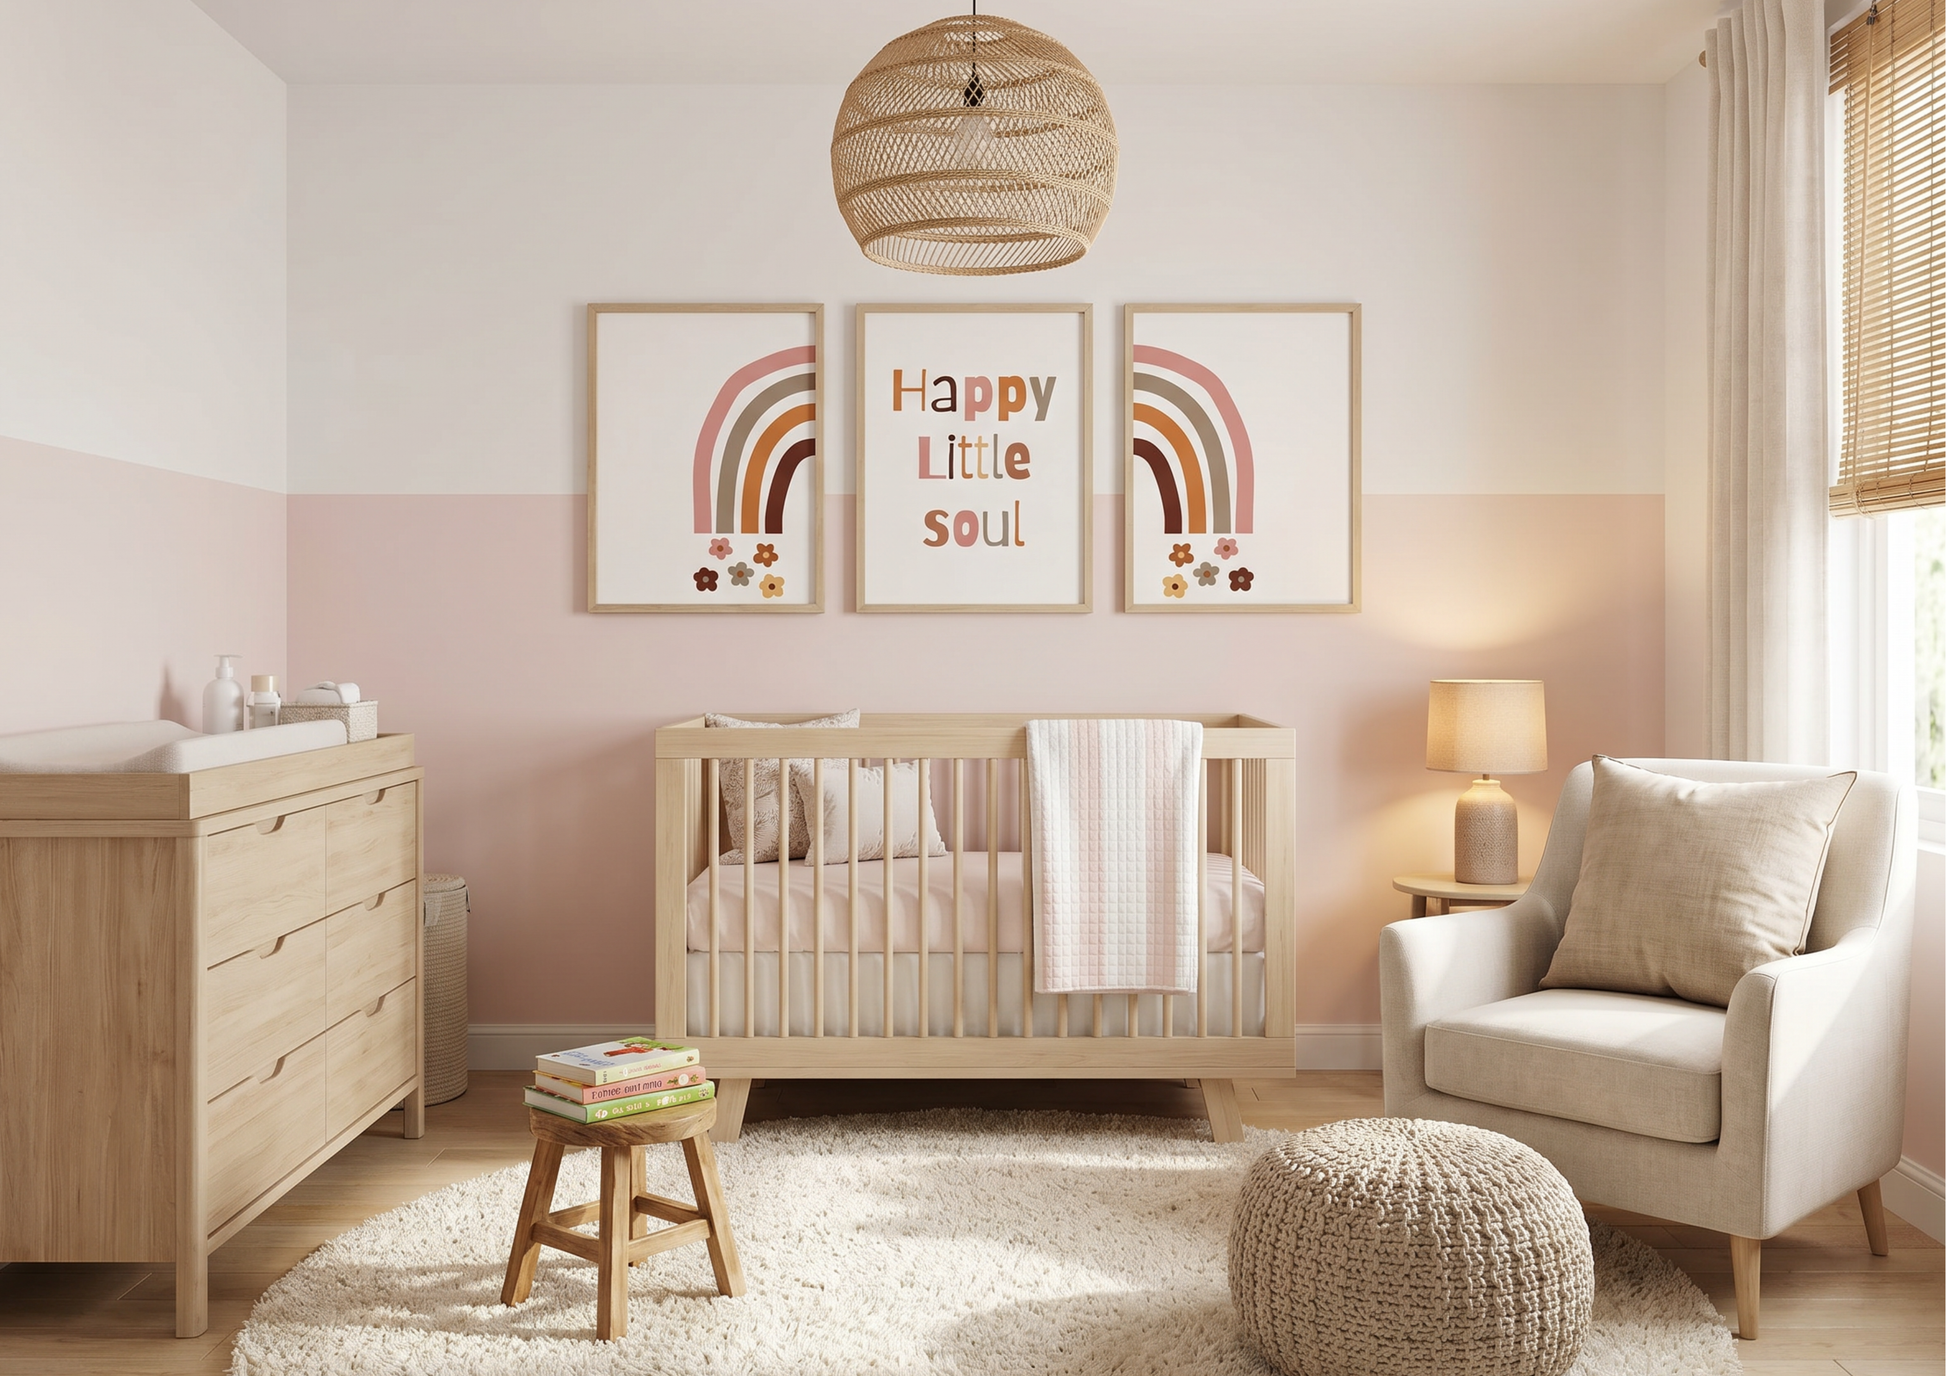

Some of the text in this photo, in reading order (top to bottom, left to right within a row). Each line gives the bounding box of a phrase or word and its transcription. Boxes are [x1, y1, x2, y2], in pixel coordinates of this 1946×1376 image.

[892, 368, 1057, 422] Happy
[918, 433, 1032, 480] Little
[922, 499, 1026, 548] soul
